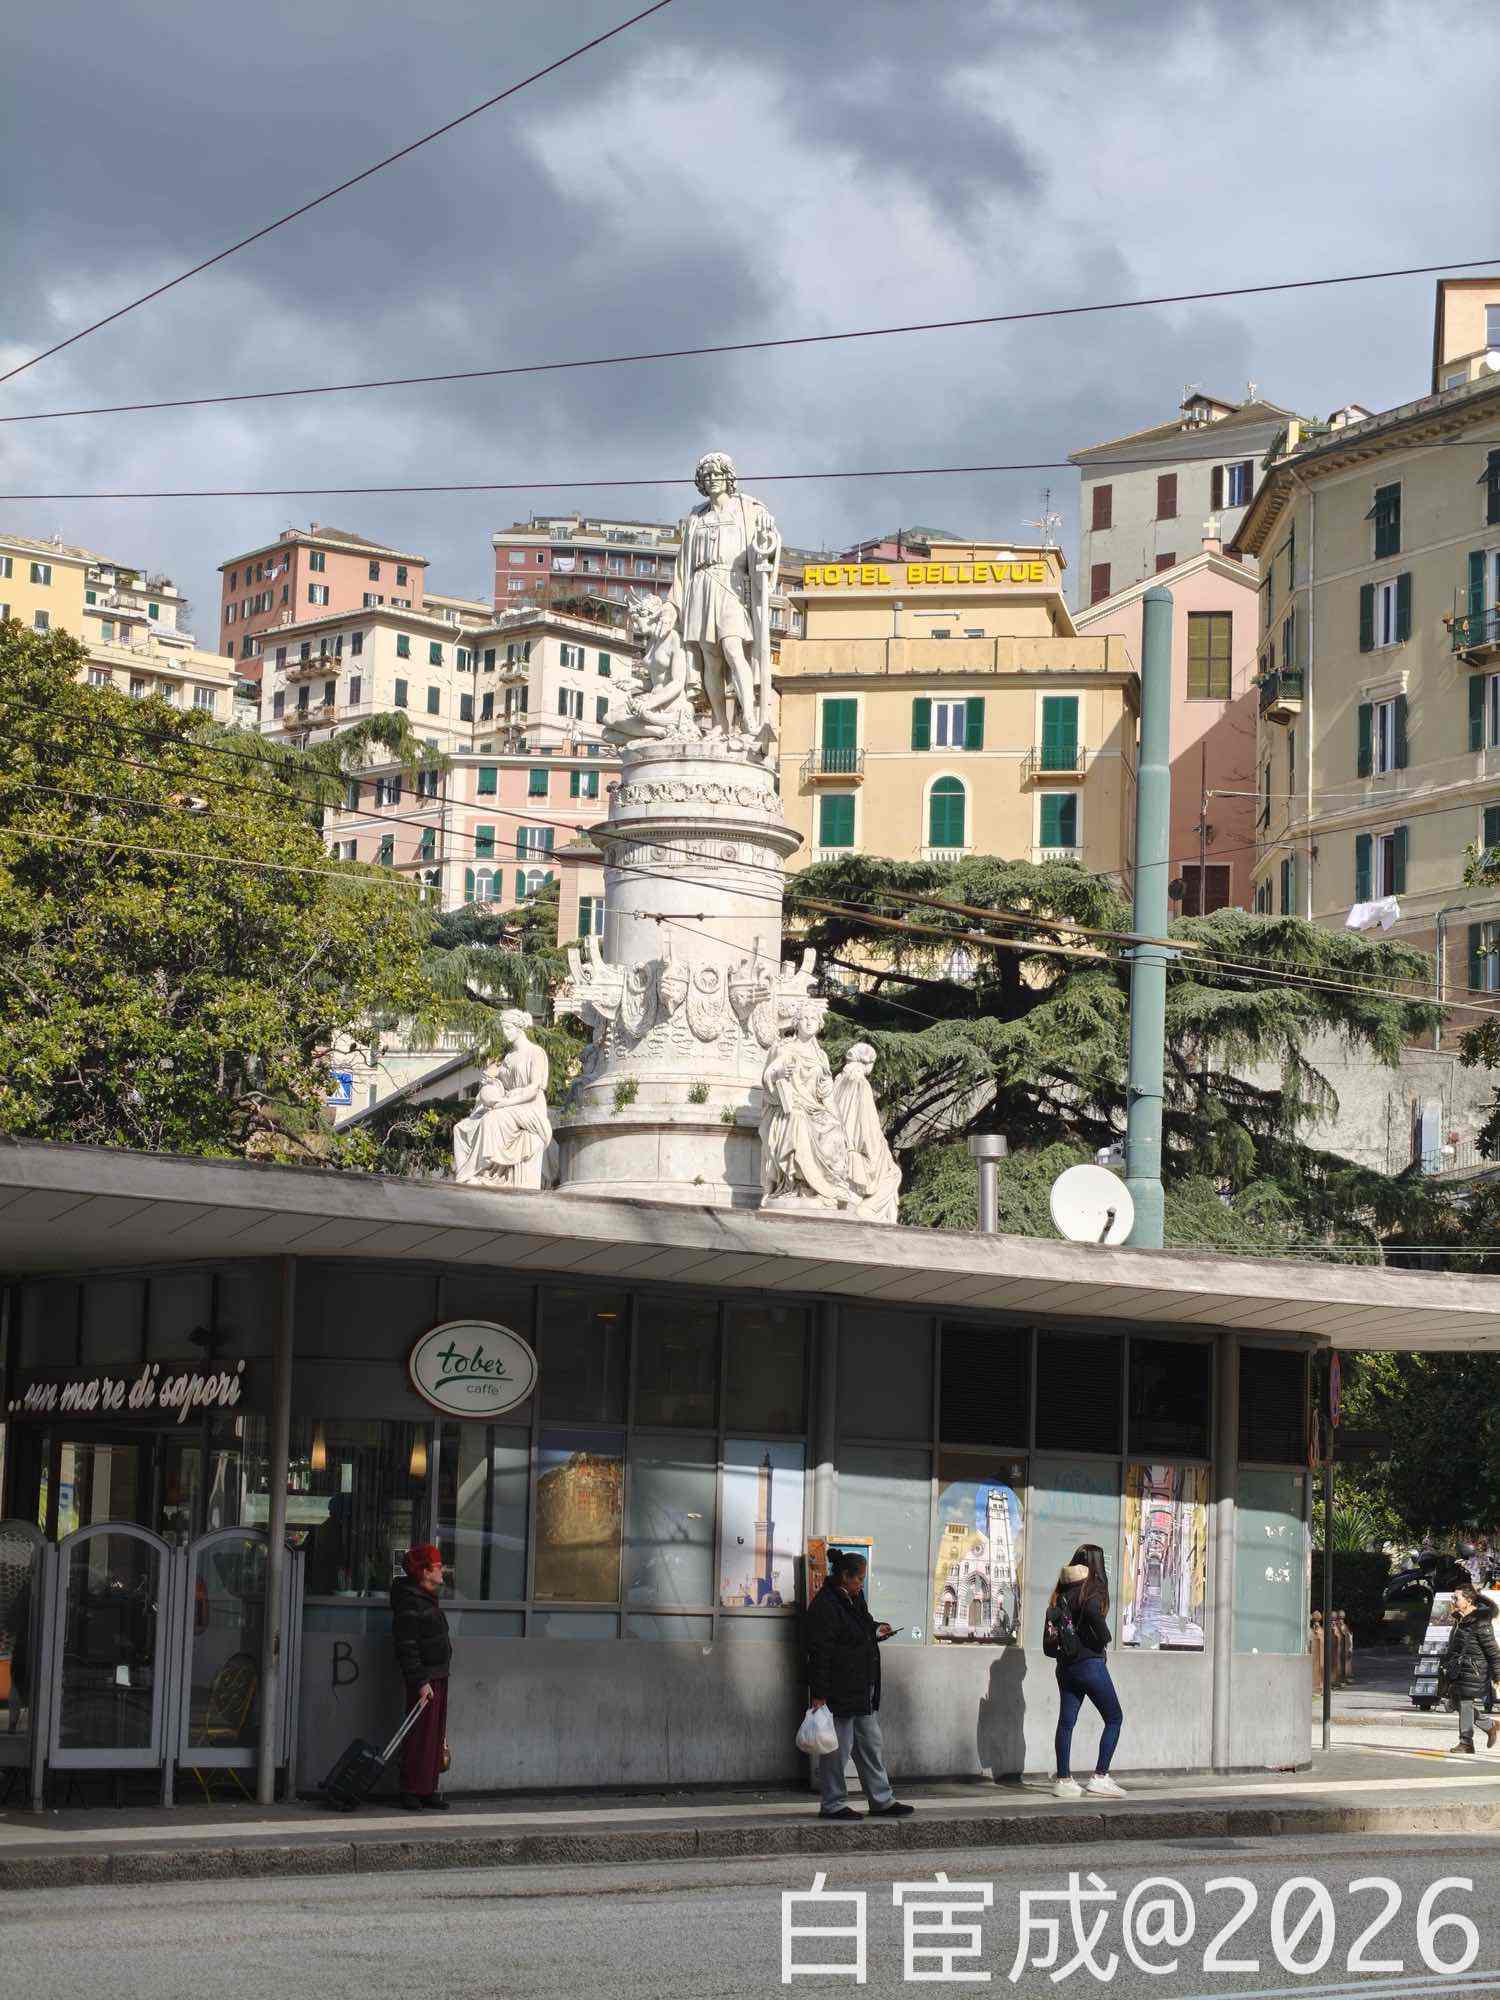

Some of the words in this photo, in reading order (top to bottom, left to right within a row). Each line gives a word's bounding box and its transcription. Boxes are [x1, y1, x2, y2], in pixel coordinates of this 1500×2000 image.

[803, 565, 892, 586] HOTEL
[906, 562, 1046, 585] BELLEVUE
[436, 1340, 506, 1375] tober
[60, 1376, 126, 1411] mare
[128, 1362, 160, 1410] di
[159, 1359, 246, 1424] sapori
[332, 1640, 359, 1686] B
